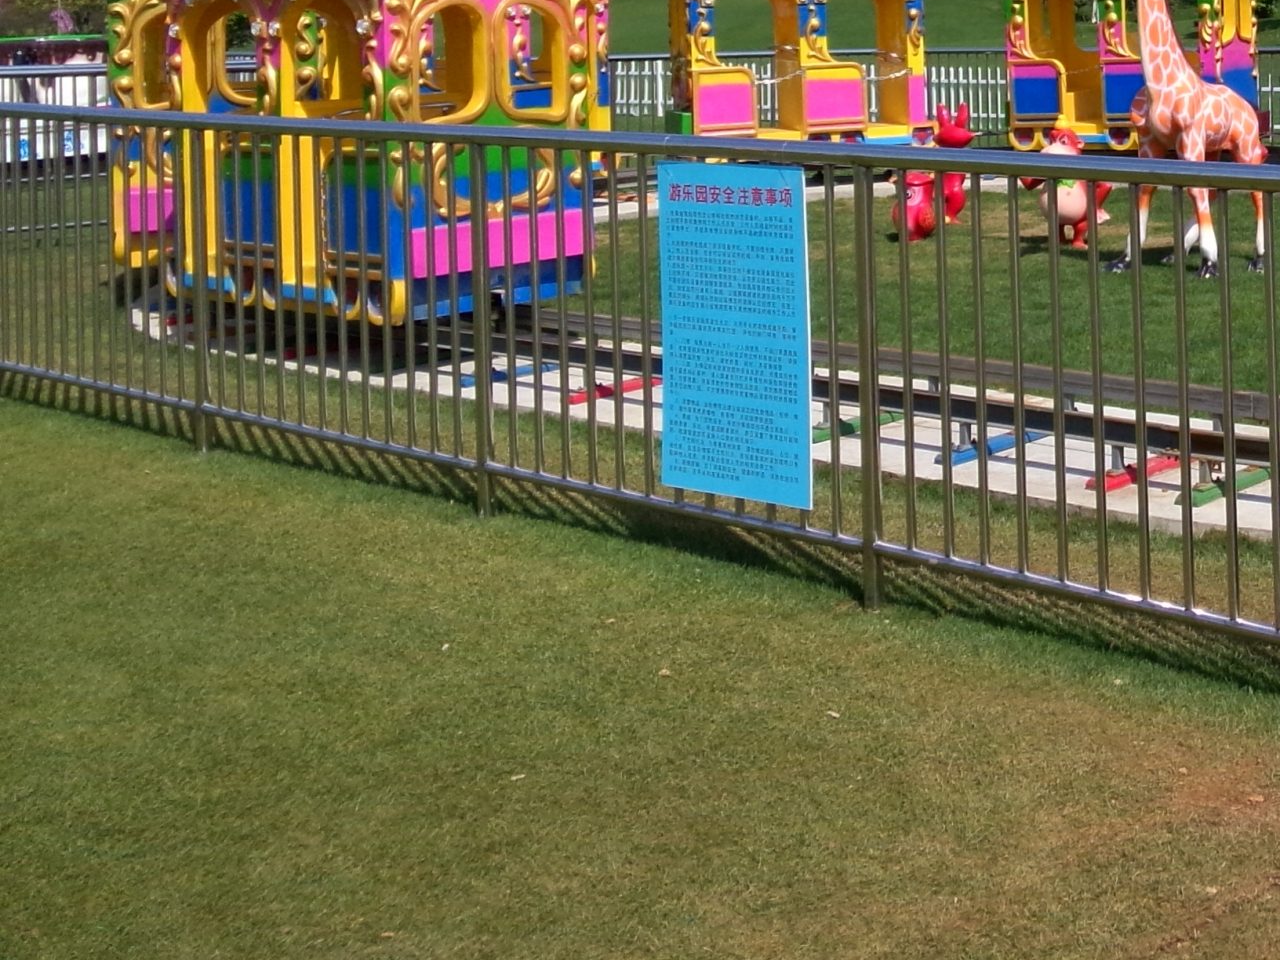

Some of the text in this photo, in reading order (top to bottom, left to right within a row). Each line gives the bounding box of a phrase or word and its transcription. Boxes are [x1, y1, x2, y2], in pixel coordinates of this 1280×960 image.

[669, 183, 793, 208] 游乐园安全注意事项
